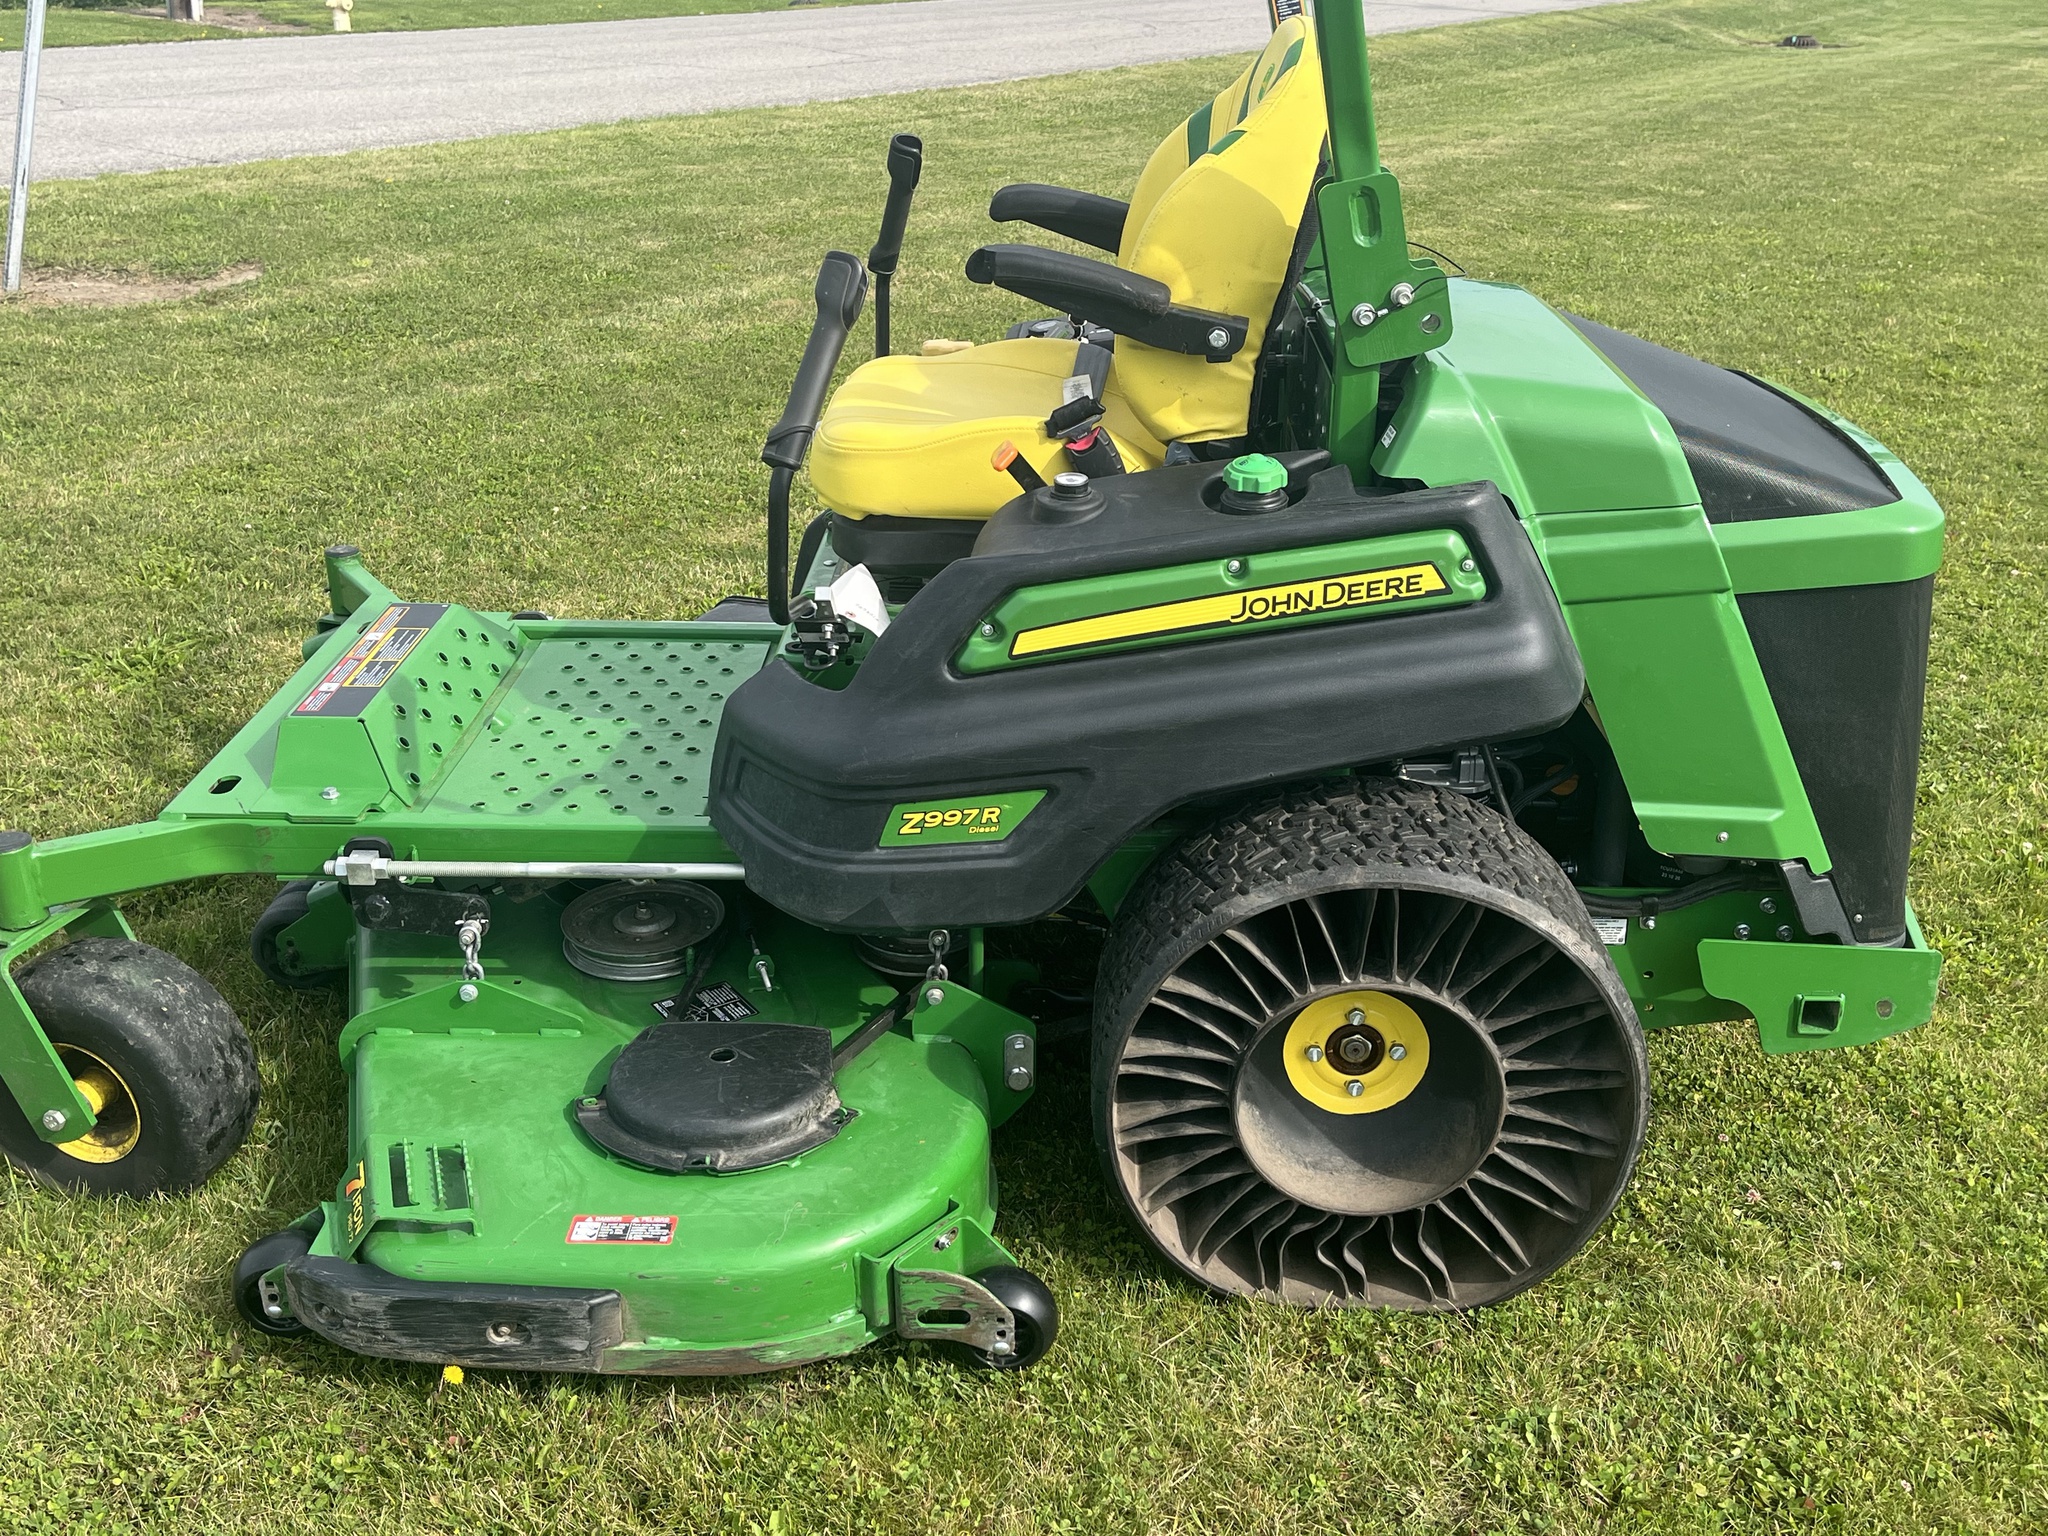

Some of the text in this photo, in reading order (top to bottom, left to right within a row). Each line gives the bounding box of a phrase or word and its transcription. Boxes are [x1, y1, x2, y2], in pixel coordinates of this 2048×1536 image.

[1230, 573, 1424, 620] JOHN DEERE
[968, 824, 999, 834] Diesel
